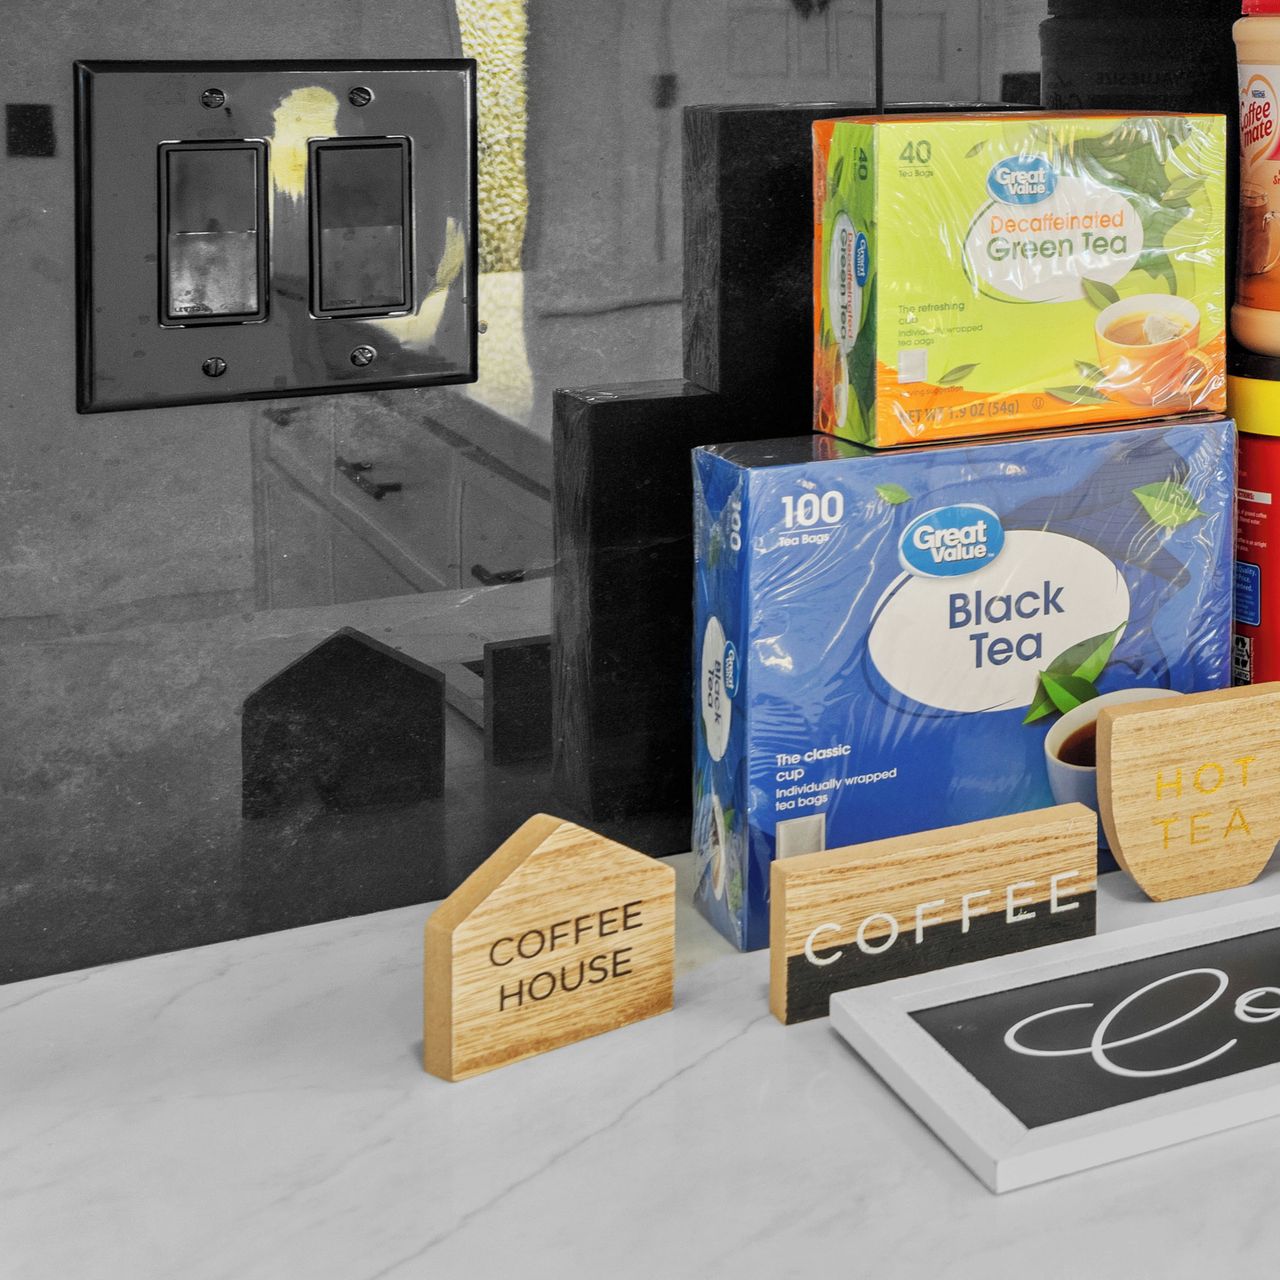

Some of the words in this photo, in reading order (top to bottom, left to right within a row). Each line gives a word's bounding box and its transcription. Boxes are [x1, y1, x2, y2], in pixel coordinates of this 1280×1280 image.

[1243, 119, 1273, 149] mate
[857, 147, 868, 181] 40
[899, 140, 932, 164] 40
[898, 170, 913, 178] Tea
[995, 166, 1047, 186] Great
[1008, 181, 1046, 196] Value
[990, 210, 1125, 235] Decaffeinated
[987, 236, 1074, 262] Green
[1081, 231, 1128, 254] Tea
[918, 301, 965, 314] refreshing
[970, 402, 986, 418] OZ
[988, 399, 1020, 418] (54g)
[781, 490, 844, 528] 100
[779, 537, 800, 547] Tea
[801, 533, 831, 545] Bags
[913, 520, 988, 550] Great
[930, 542, 987, 564] Value
[949, 580, 1066, 629] Black
[969, 631, 1043, 669] Tea
[776, 752, 801, 767] The
[804, 743, 852, 761] classic
[776, 768, 805, 782] cup
[776, 778, 842, 799] Individually
[844, 768, 898, 786] wrapped
[1155, 755, 1257, 802] HOT
[775, 800, 796, 812] tea
[797, 793, 829, 807] bags
[1152, 807, 1254, 850] TEA
[488, 898, 644, 968] COFFEE
[804, 870, 1081, 966] COFFEE
[497, 946, 634, 1012] HOUSE
